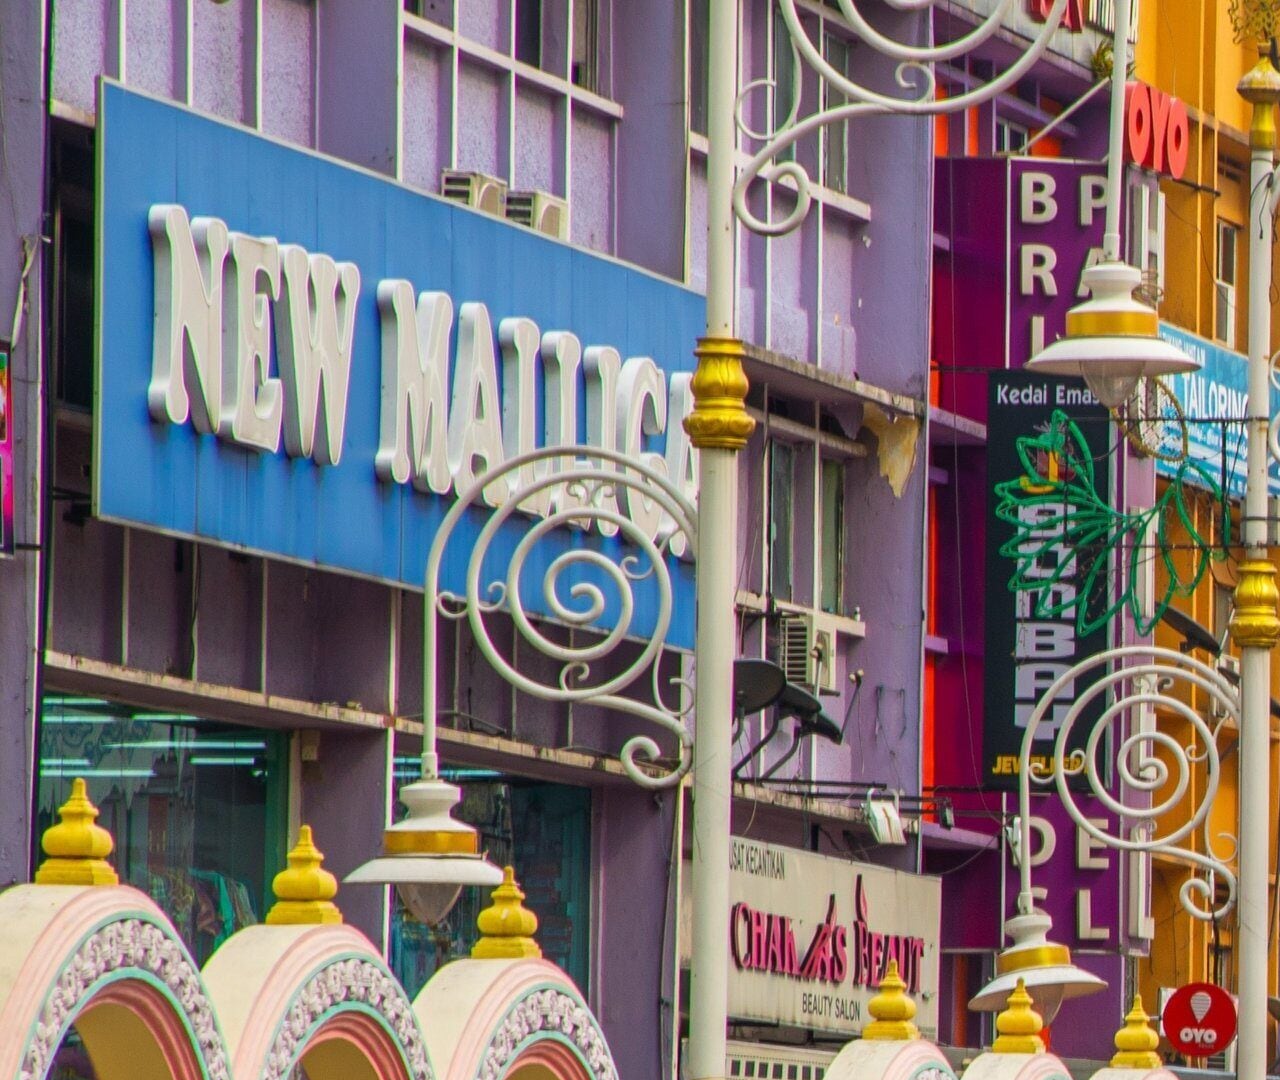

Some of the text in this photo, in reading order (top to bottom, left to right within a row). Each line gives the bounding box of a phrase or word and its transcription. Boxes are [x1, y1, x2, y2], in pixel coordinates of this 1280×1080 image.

[1127, 82, 1189, 180] OYO
[148, 203, 361, 467] NEW
[997, 384, 1102, 406] Kedai Emas
[802, 992, 861, 1022] BEAUTY SALON
[1179, 1028, 1217, 1044] OYO
